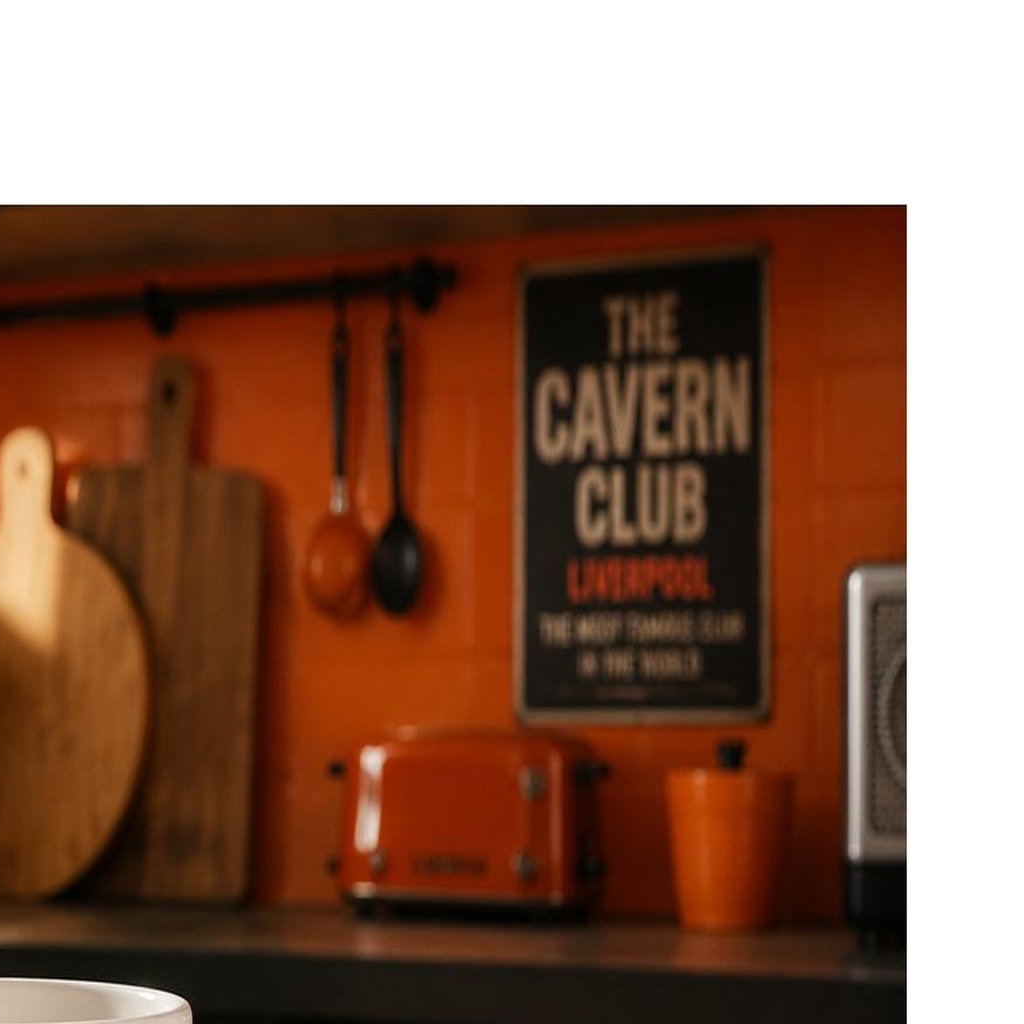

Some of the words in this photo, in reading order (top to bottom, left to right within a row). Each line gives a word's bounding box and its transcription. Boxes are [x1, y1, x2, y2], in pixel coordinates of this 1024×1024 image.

[603, 293, 679, 356] THE
[533, 356, 752, 465] CAVERN
[576, 463, 708, 547] CLUB
[567, 555, 714, 603] LIVERPOOL
